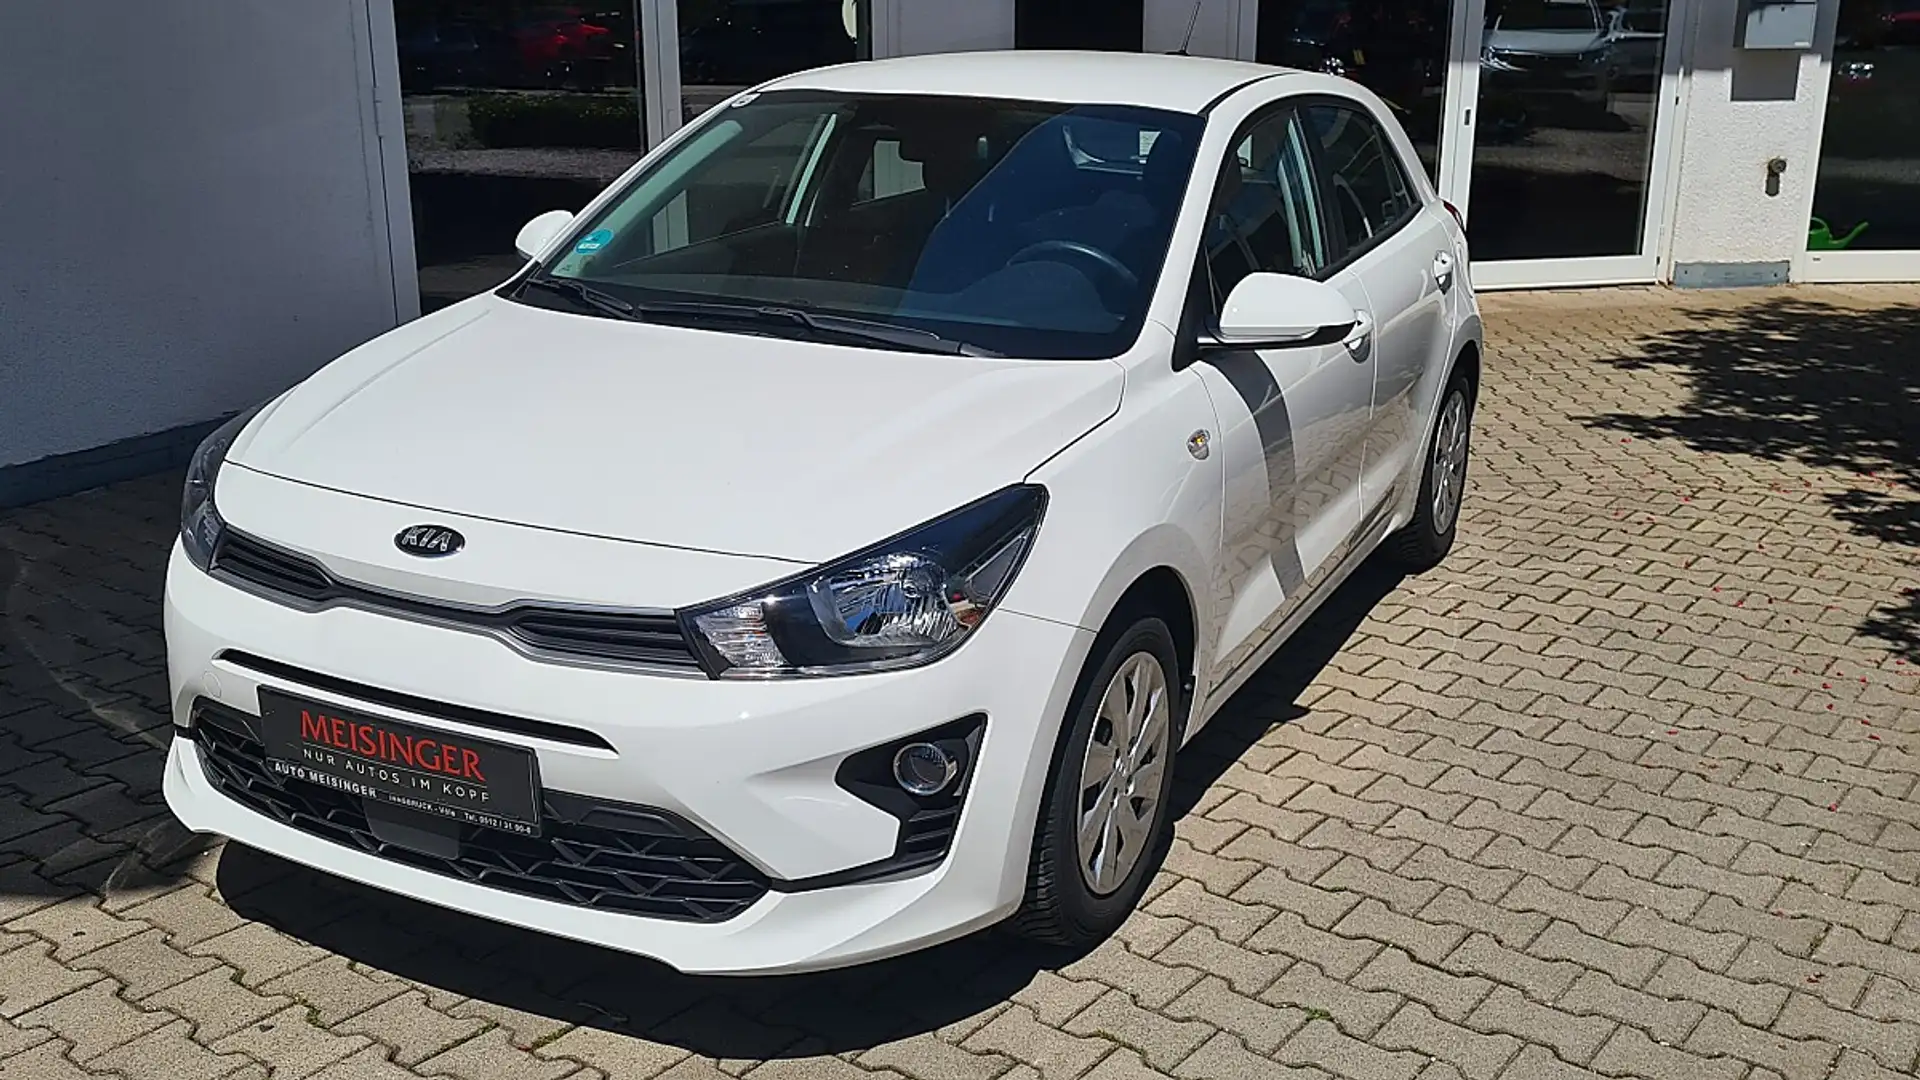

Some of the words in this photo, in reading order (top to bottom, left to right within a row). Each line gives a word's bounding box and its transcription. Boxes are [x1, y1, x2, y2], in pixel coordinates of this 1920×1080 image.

[401, 526, 452, 551] KIA
[300, 710, 486, 782] MEISINGER
[275, 762, 305, 779] AUTO
[309, 771, 377, 798] MEISINGER
[303, 748, 336, 766] NUR
[345, 760, 400, 784] AUTOS
[411, 777, 431, 790] IM
[442, 783, 490, 803] KOPF
